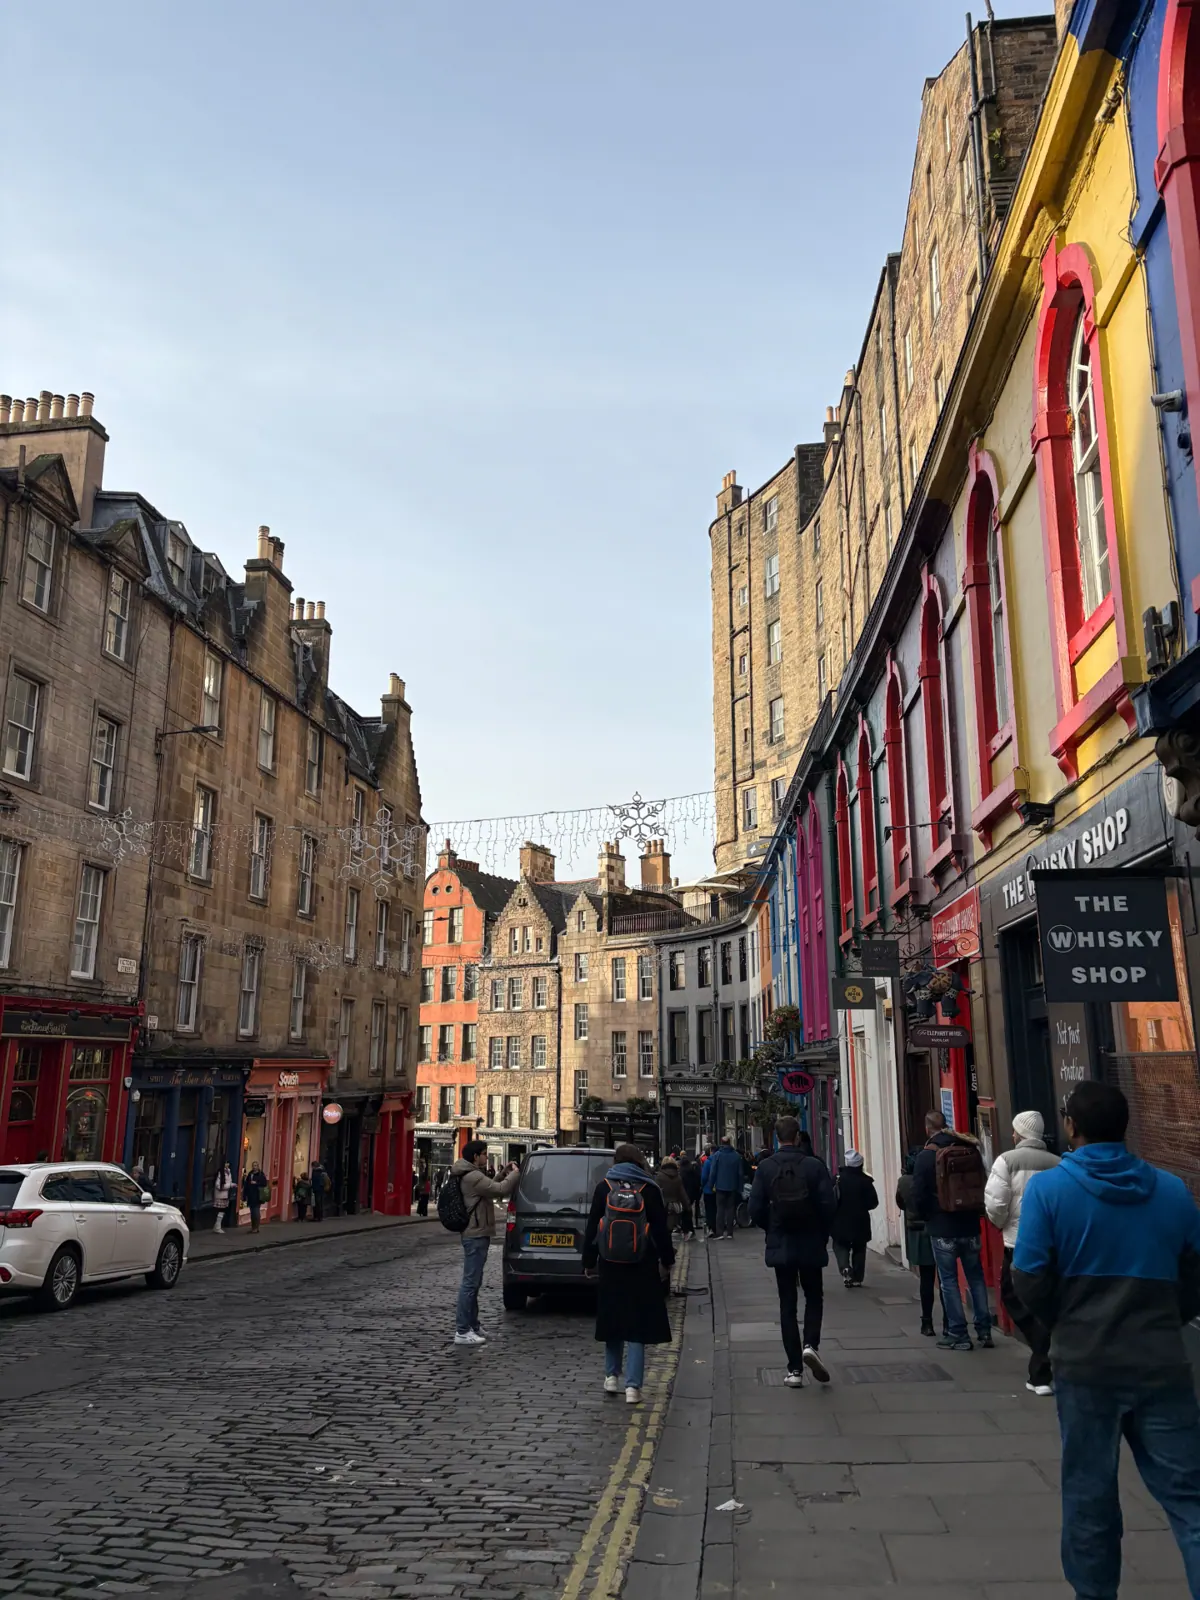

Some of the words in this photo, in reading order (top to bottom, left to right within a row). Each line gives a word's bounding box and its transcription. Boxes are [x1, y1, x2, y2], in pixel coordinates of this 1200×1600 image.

[1002, 875, 1025, 909] THE
[1082, 807, 1129, 864] SHOP
[1075, 895, 1129, 913] THE
[1049, 930, 1164, 950] WHISKY
[1071, 966, 1148, 985] SHOP
[1056, 1019, 1069, 1045] Not
[278, 1071, 299, 1088] Squish
[1060, 1057, 1085, 1083] Another
[531, 1233, 554, 1245] HN67
[555, 1234, 573, 1245] WDW
